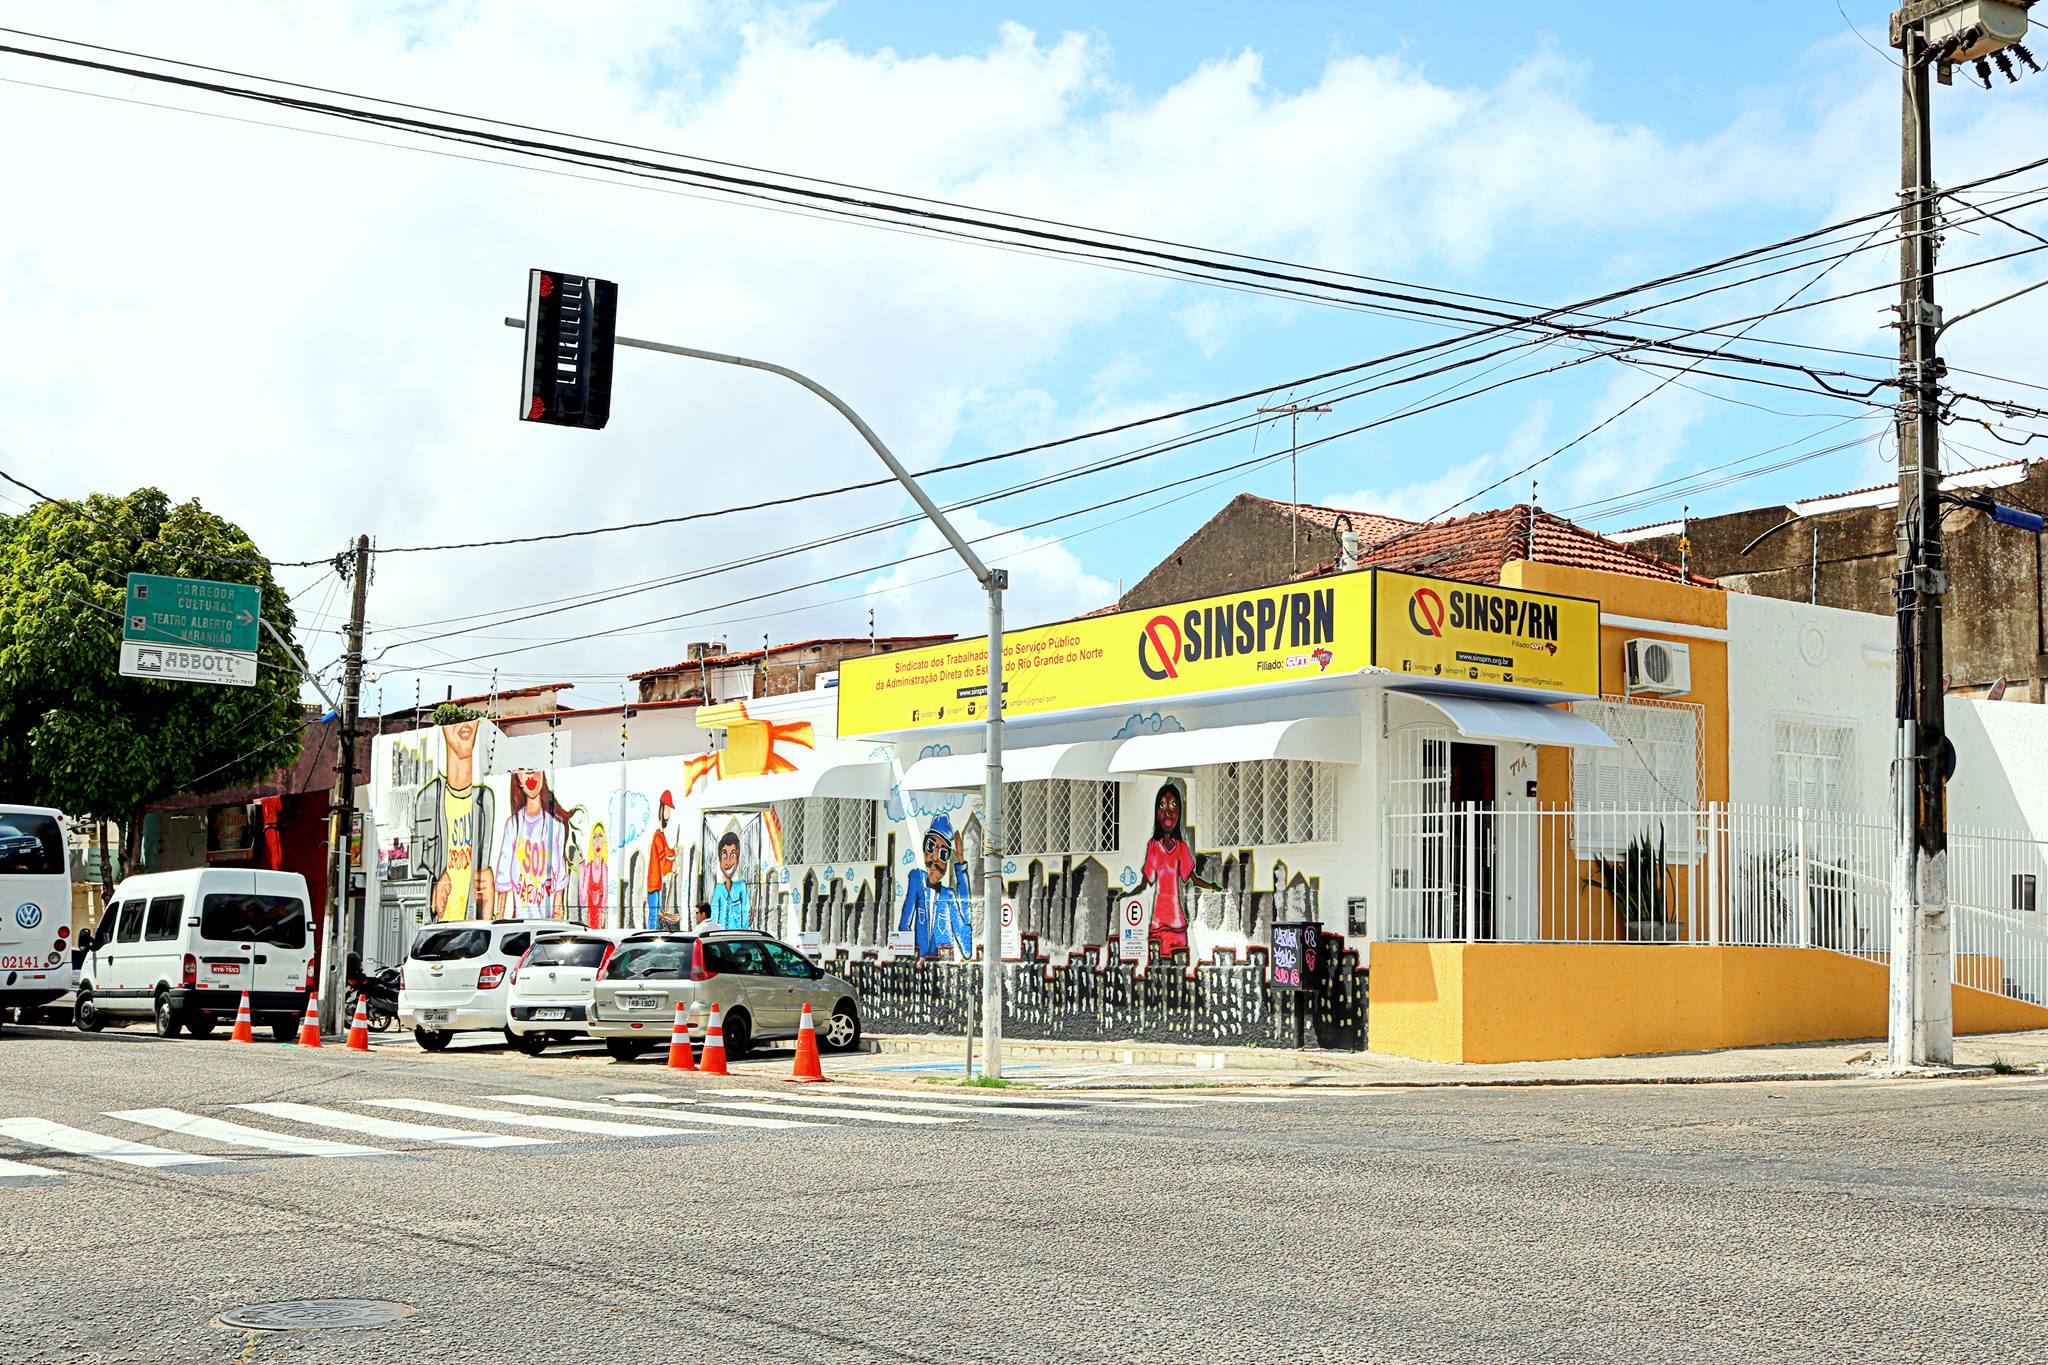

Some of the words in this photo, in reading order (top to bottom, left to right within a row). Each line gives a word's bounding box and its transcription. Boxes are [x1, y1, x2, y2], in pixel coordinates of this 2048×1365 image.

[177, 584, 235, 600] CORREDOR
[178, 598, 233, 613] CULTURAL
[152, 612, 187, 626] TEATRO
[191, 617, 232, 631] ALBERTO
[1449, 590, 1558, 641] SINSP/RN
[1184, 588, 1334, 663] SINSP/RN
[895, 659, 929, 673] Sindicato
[931, 657, 944, 667] dos
[1004, 645, 1013, 657] do
[1016, 640, 1047, 654] Serviço
[1049, 635, 1081, 649] Público
[876, 680, 885, 690] da
[886, 672, 938, 688] Administração
[940, 669, 962, 681] Direta
[964, 666, 974, 677] do
[1005, 660, 1016, 671] do
[1018, 657, 1032, 670] Rio
[1034, 652, 1064, 668] Grande
[1066, 651, 1078, 662] do
[1080, 648, 1104, 661] Norte
[1257, 659, 1284, 672] Filiado:
[1131, 905, 1138, 921] E
[2, 956, 39, 969] 02141
